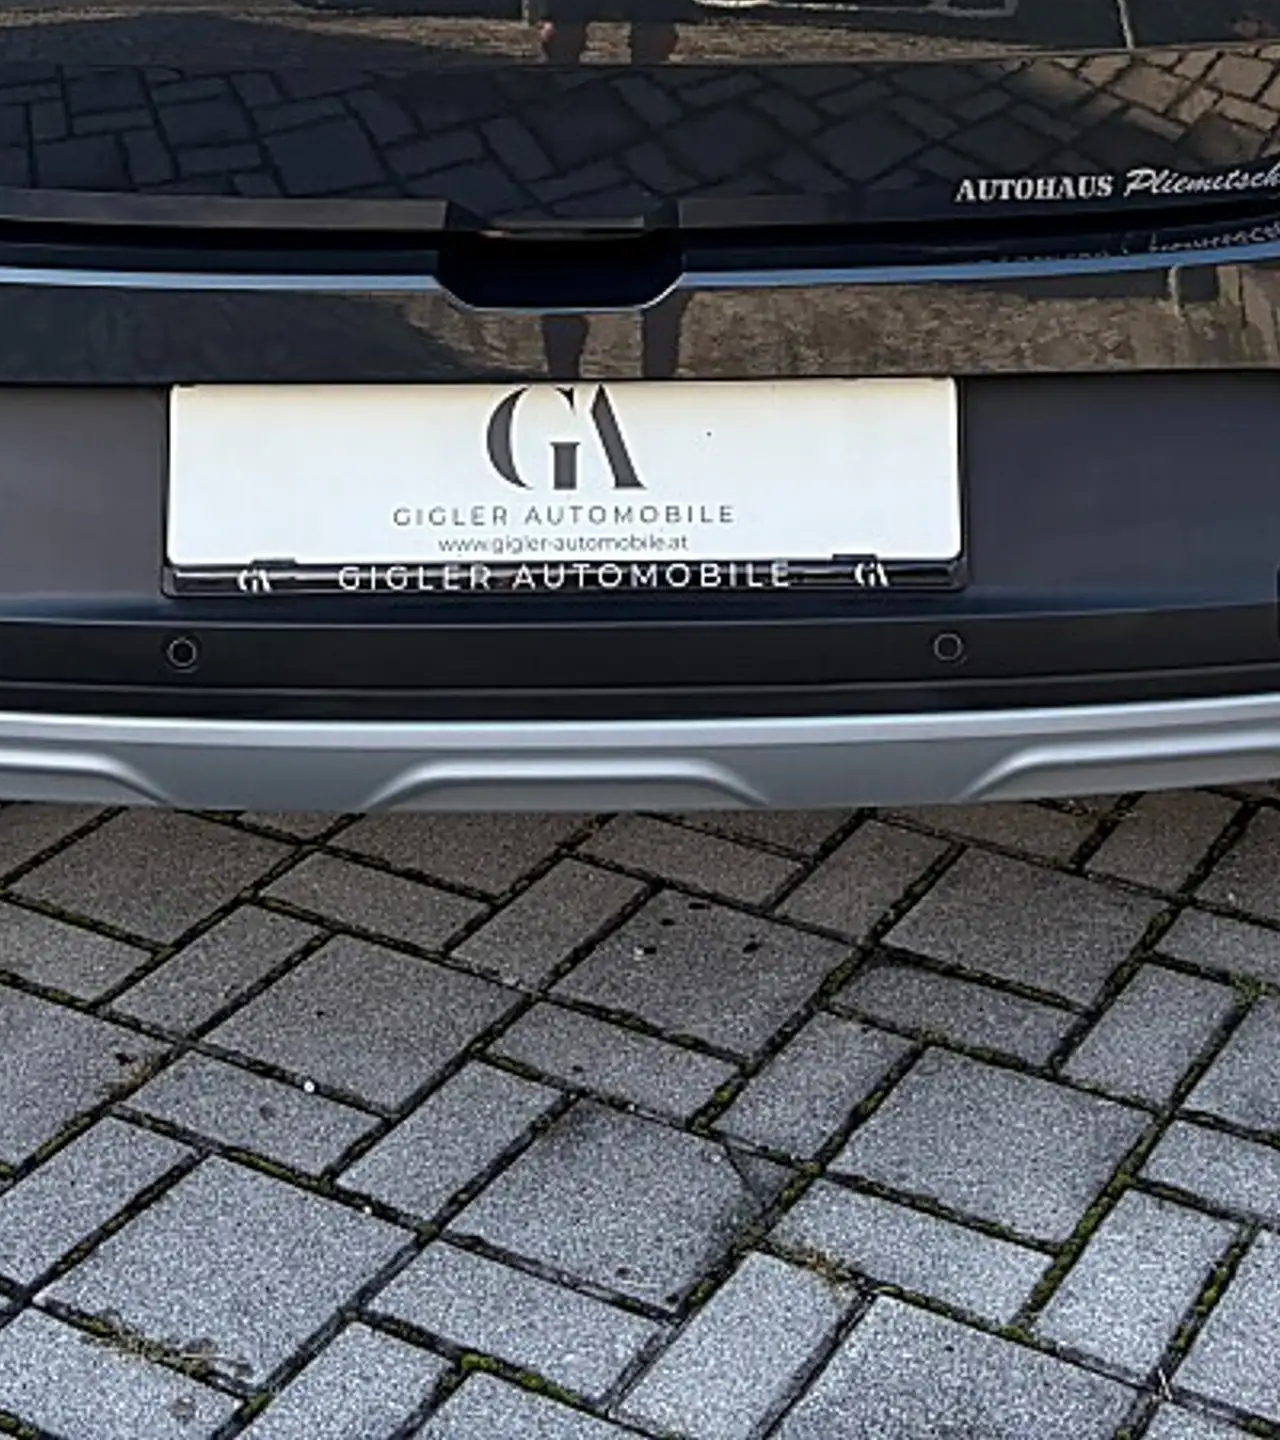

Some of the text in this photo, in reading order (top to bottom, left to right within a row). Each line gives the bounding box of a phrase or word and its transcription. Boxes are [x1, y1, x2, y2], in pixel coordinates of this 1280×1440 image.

[954, 174, 1114, 202] AUTOHAUS
[486, 383, 646, 490] GA
[393, 505, 735, 526] GIGLER AUTOMOBILE
[438, 532, 689, 553] www.gigler-automobile.at
[338, 566, 491, 591] GIGLER
[511, 563, 790, 590] AUTOMOBILE
